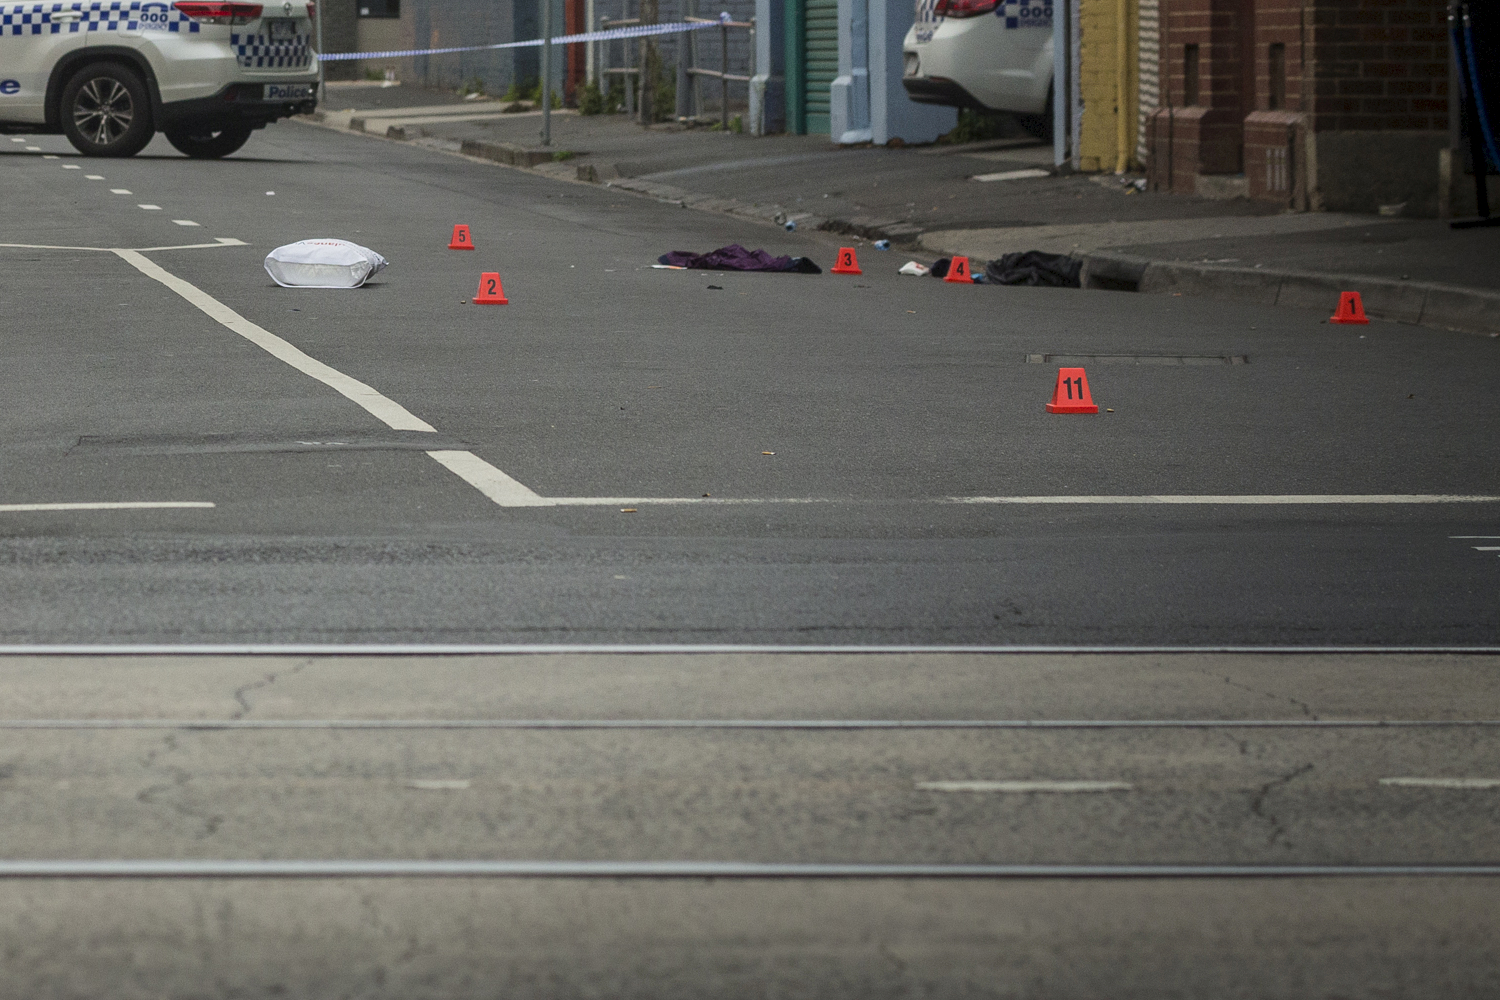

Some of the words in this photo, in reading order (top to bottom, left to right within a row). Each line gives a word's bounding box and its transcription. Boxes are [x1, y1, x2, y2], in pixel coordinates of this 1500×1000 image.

[140, 13, 169, 23] 000
[1020, 6, 1053, 18] 000
[268, 85, 308, 98] Police
[458, 229, 466, 243] 5
[844, 253, 852, 266] 3
[956, 262, 964, 276] 4
[487, 279, 497, 295] 2
[1348, 297, 1356, 315] 1
[1063, 376, 1083, 400] 11
